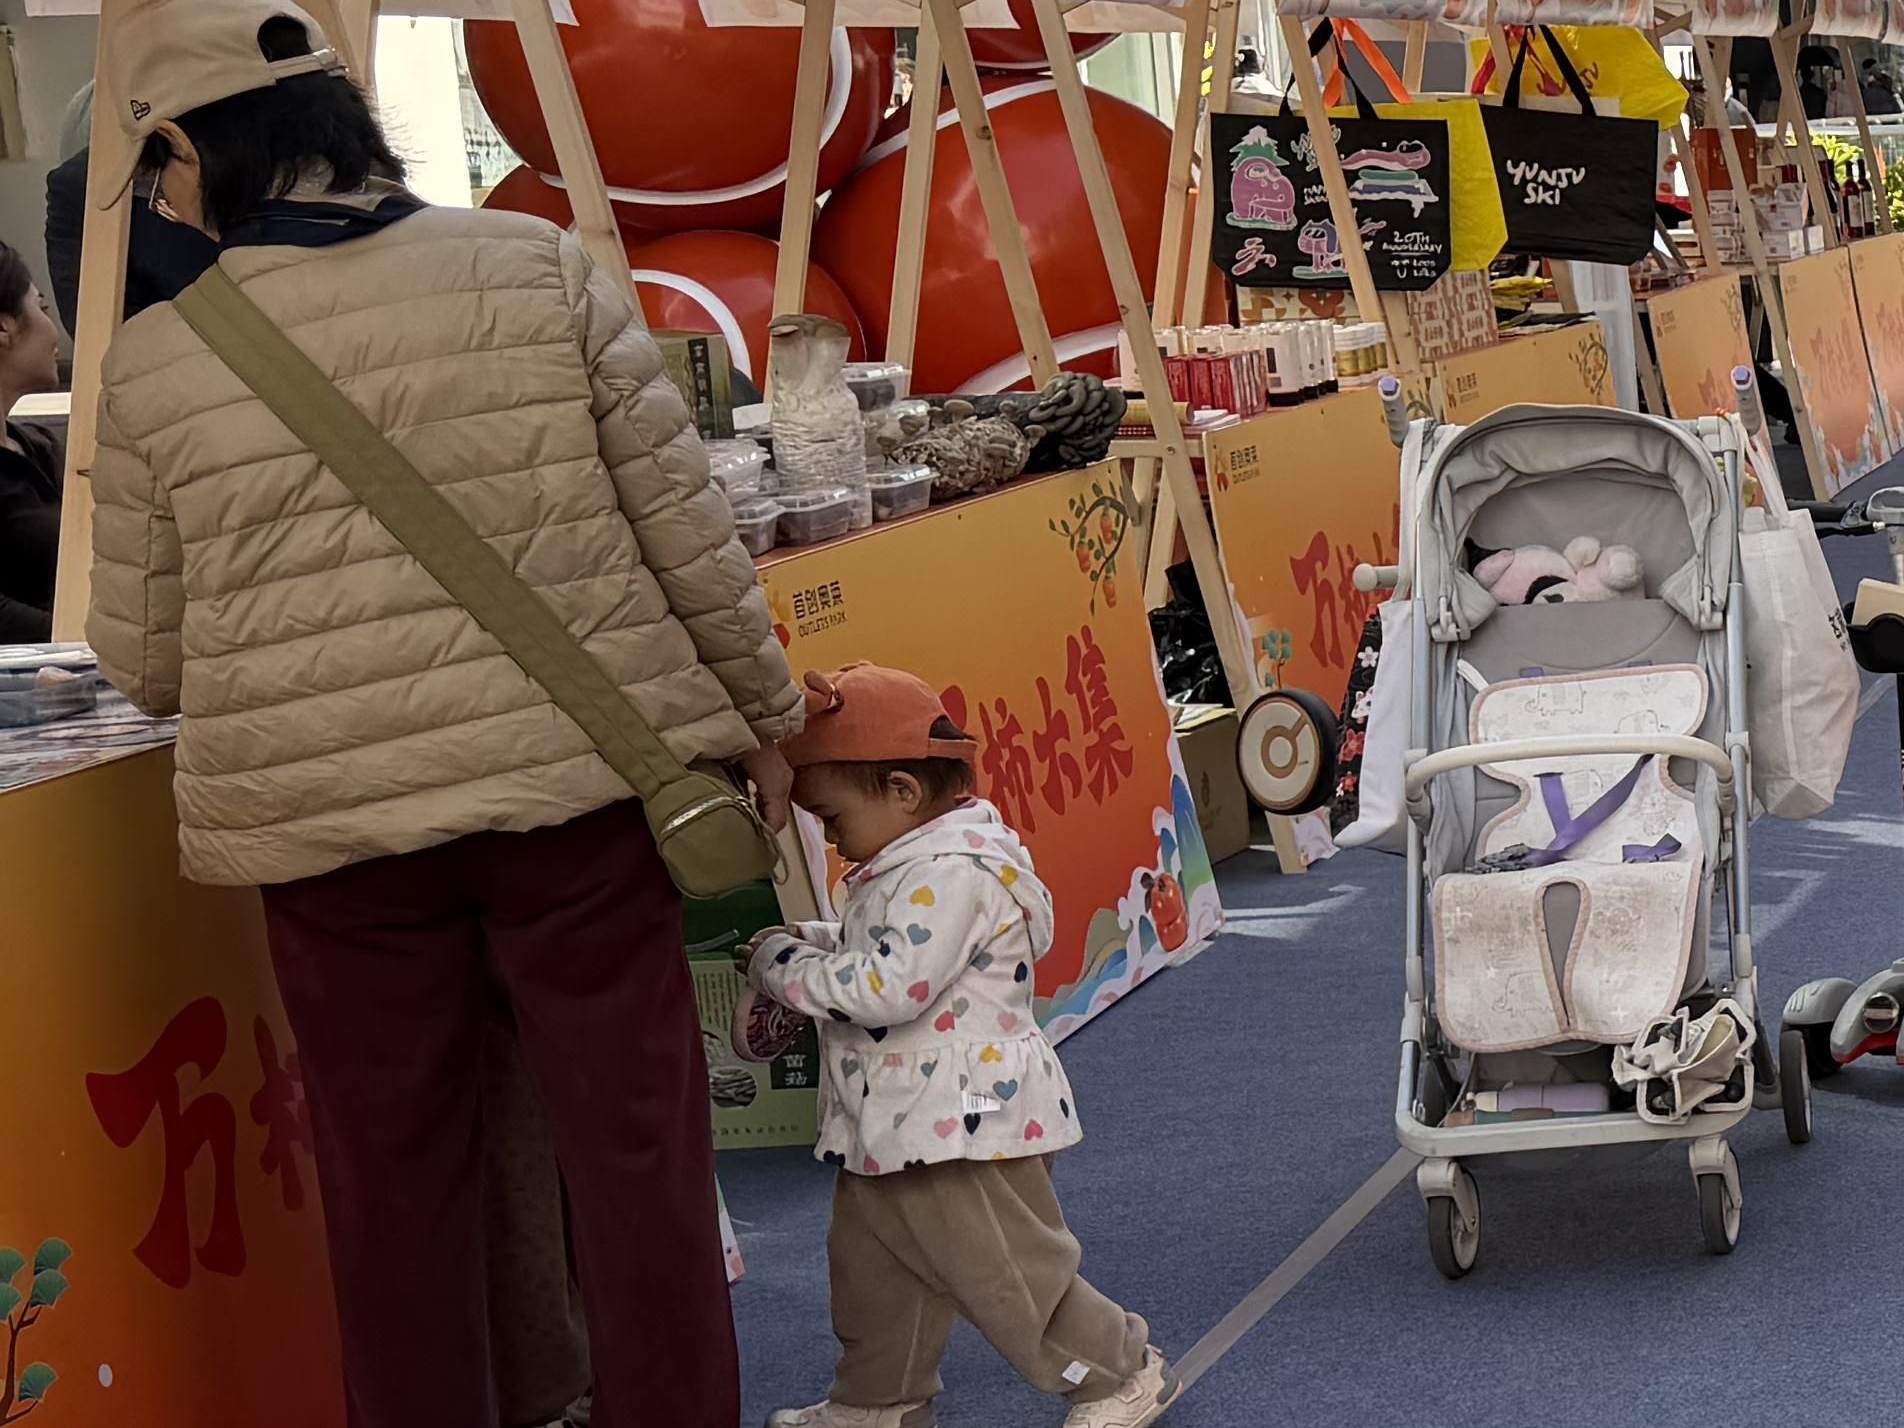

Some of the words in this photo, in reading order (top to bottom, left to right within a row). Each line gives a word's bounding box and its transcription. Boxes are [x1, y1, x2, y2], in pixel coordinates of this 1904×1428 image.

[1524, 183, 1561, 205] SKI
[937, 625, 1134, 833] 柿大集
